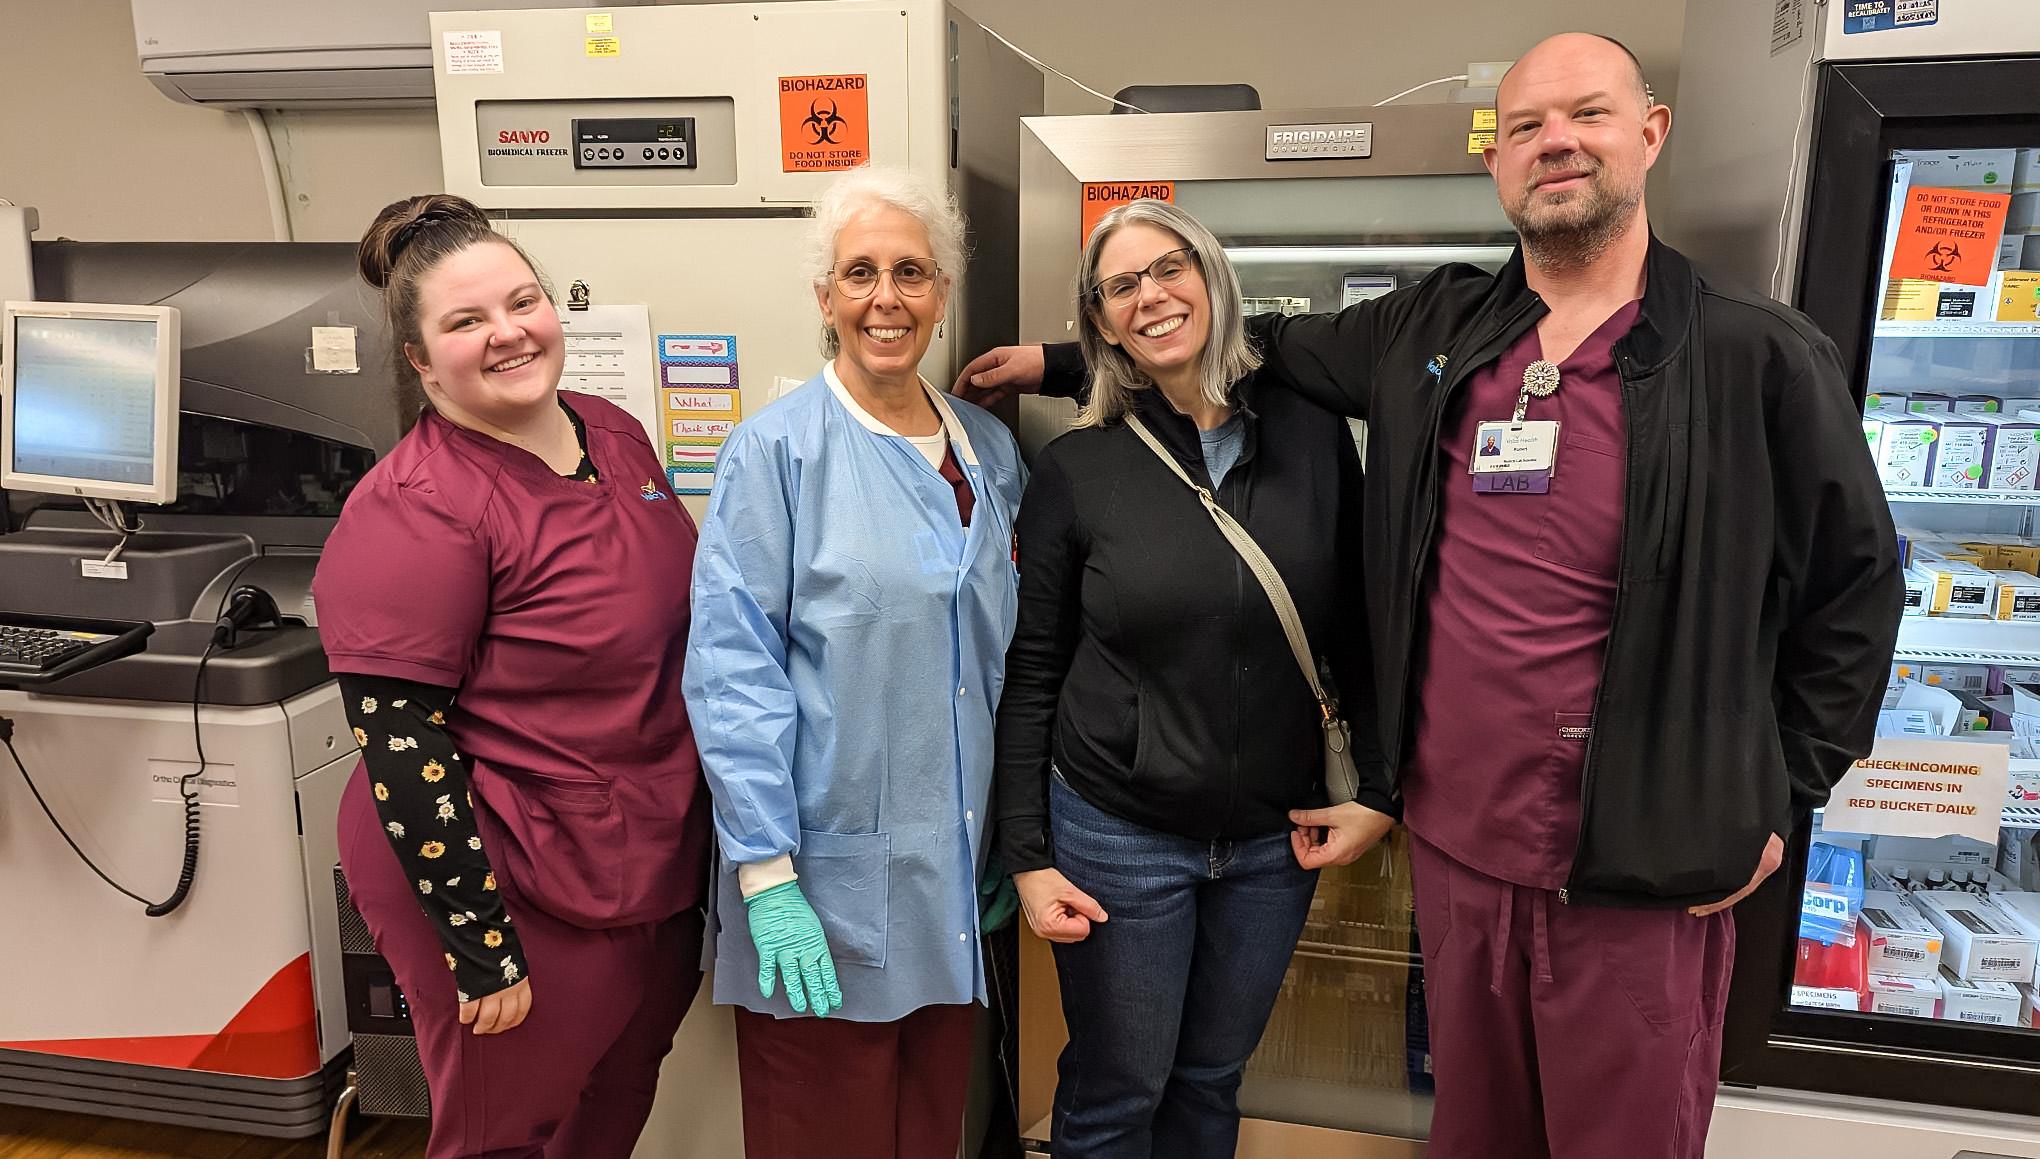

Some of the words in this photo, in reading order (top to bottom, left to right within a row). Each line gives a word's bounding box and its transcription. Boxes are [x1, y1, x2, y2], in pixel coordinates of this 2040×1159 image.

[1854, 3, 1872, 11] TIME
[1874, 1, 1885, 9] TO
[781, 77, 864, 92] BIOHAZARD
[498, 130, 550, 144] SANYO
[1273, 129, 1365, 144] FRIGIDAIRE
[488, 148, 533, 157] BIOMEDICAL
[536, 148, 569, 157] FREEZER
[789, 151, 804, 160] DO
[806, 150, 825, 159] NOT
[829, 150, 862, 159] STORE
[795, 160, 823, 168] FOOD
[825, 159, 857, 167] INSIDE
[1087, 185, 1170, 201] BIOHAZARD
[1916, 193, 1929, 202] DO
[1931, 194, 1947, 203] NOT
[1949, 196, 1977, 206] STORE
[1979, 199, 2001, 209] FOOD
[1920, 204, 1932, 213] OR
[1934, 205, 1960, 216] DRINK
[1962, 208, 1971, 217] IN
[1973, 209, 1992, 219] THIS
[1922, 215, 1984, 228] REFRIGERATOR
[1915, 225, 1947, 236] AND/OR
[1949, 228, 1985, 239] FREEZER
[673, 422, 702, 433] Thank
[1491, 474, 1530, 491] LAB
[1856, 759, 1901, 771] CHECK
[1905, 762, 1978, 776] INCOMING
[152, 775, 173, 783] Ortho
[1866, 778, 1943, 792] SPECIMENS
[1947, 783, 1963, 793] IN
[1848, 798, 1876, 809] RED
[1880, 800, 1933, 812] BUCKET
[1936, 803, 1976, 816] DAILY
